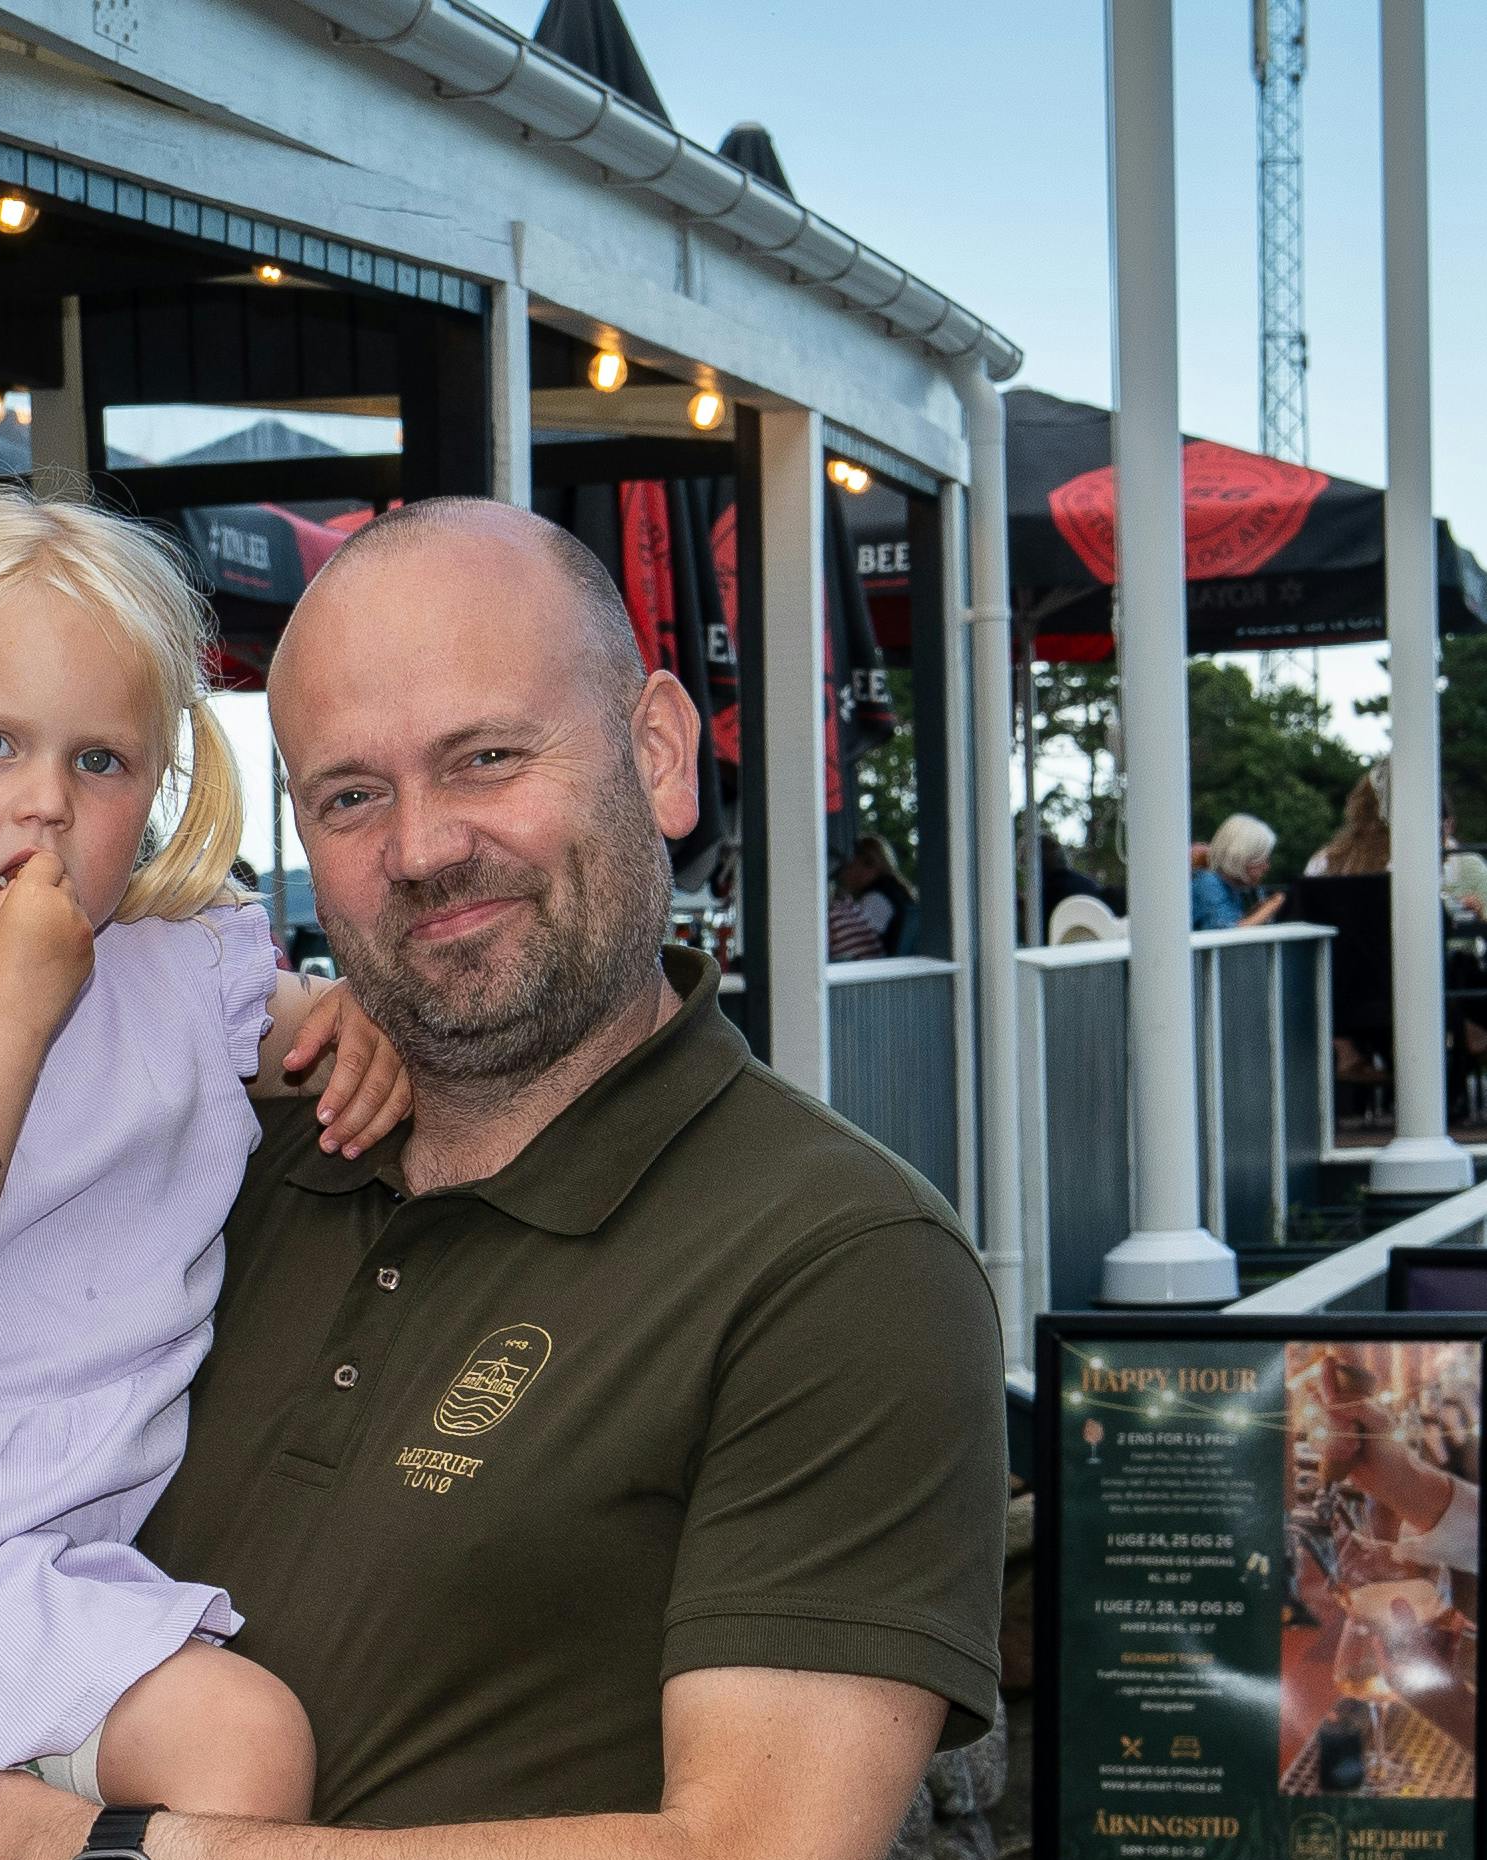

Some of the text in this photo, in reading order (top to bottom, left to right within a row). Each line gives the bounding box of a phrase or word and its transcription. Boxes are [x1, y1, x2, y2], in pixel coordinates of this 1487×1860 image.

[857, 542, 910, 574] BEE
[1081, 1366, 1258, 1393] HAPPY HOUR
[1156, 1432, 1184, 1446] FOR
[396, 1447, 483, 1478] MEJERIET
[404, 1470, 453, 1494] TUNØ
[1115, 1534, 1146, 1547] UGE
[1148, 1534, 1169, 1549] 24,
[1191, 1534, 1213, 1548] OG
[1103, 1600, 1133, 1614] UGE
[1200, 1601, 1223, 1616] OG
[1093, 1807, 1240, 1839] ÅBNINGSTID
[1347, 1829, 1447, 1849] MEJERIET
